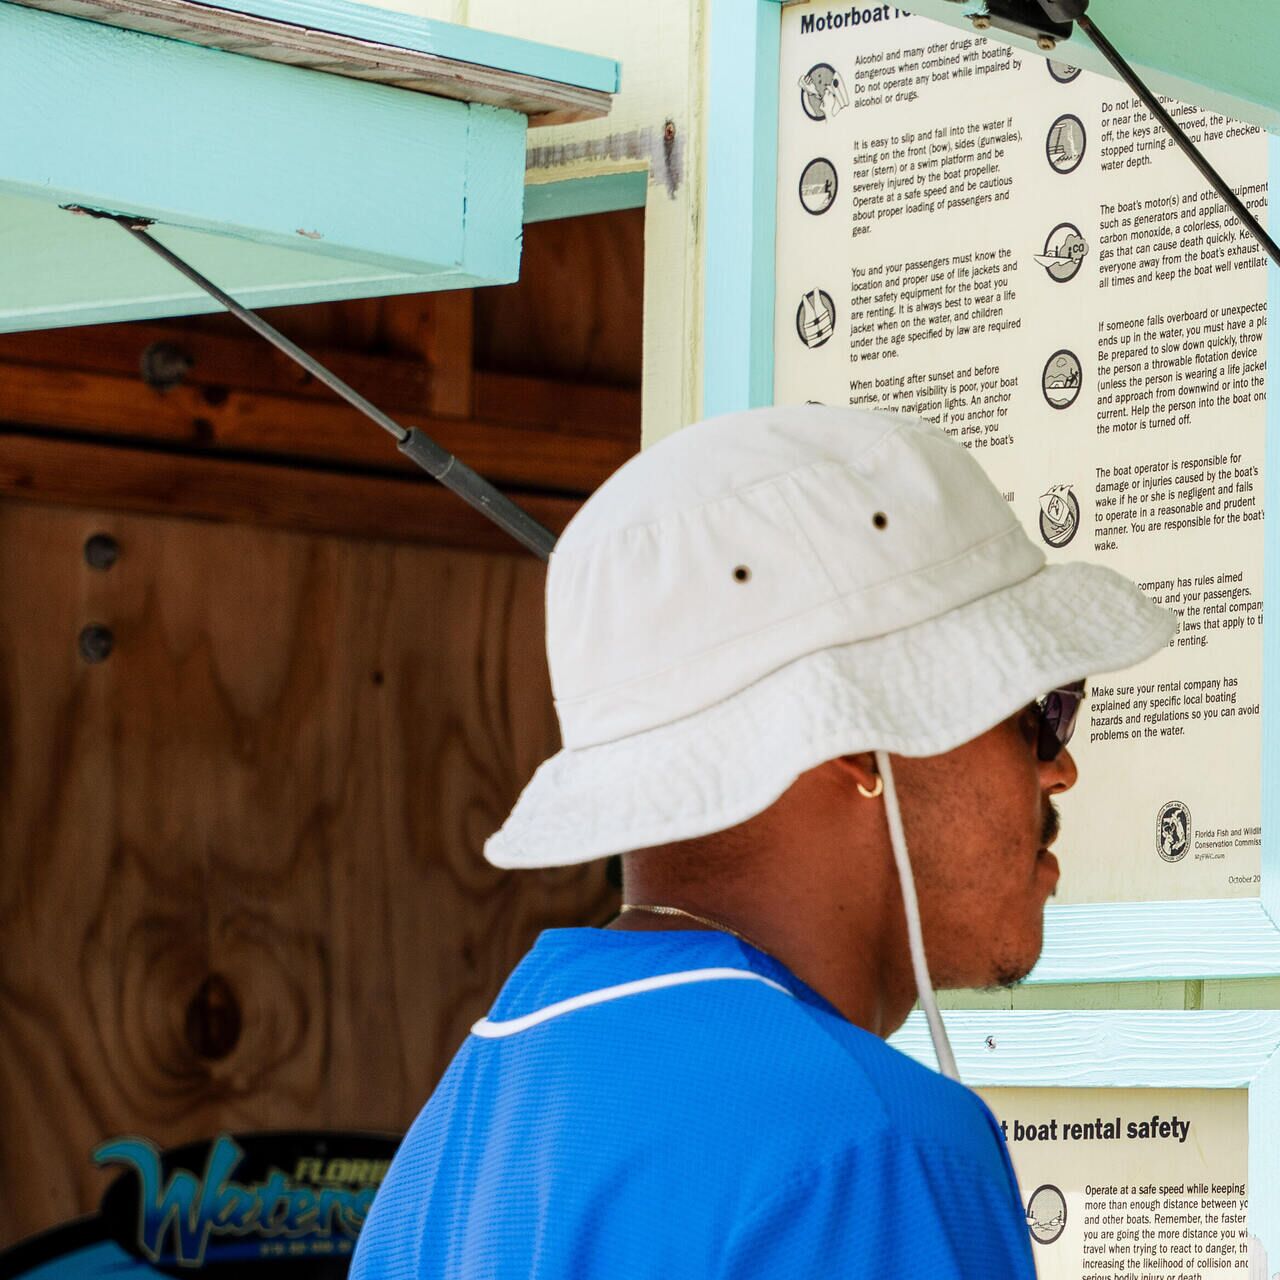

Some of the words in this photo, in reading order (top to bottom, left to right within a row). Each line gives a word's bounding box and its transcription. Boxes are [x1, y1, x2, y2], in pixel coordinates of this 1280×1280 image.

[801, 4, 889, 34] Motorboat
[853, 52, 884, 66] Alcohol
[885, 49, 901, 61] and
[902, 47, 925, 61] many
[926, 42, 948, 55] other
[949, 38, 973, 54] drugs
[974, 38, 988, 47] are
[854, 64, 896, 82] dangerous
[897, 60, 919, 73] when
[921, 54, 960, 70] combined
[962, 51, 979, 63] with
[981, 45, 1014, 62] boating.
[854, 83, 865, 94] Do
[867, 81, 880, 92] not
[882, 76, 913, 92] operate
[915, 76, 929, 87] any
[931, 70, 949, 83] boat
[951, 67, 972, 79] while
[974, 61, 1010, 78] impaired
[1012, 59, 1021, 73] by
[853, 94, 883, 108] alcohol
[884, 95, 893, 104] or
[894, 89, 921, 105] drugs.
[1091, 685, 1114, 697] Make
[1116, 686, 1134, 695] sure
[1136, 685, 1154, 696] your
[1156, 680, 1181, 692] rental
[1183, 680, 1221, 693] company
[1222, 676, 1238, 687] has
[1090, 698, 1130, 714] explained
[1132, 700, 1147, 711] any
[1149, 695, 1181, 710] specific
[1183, 693, 1203, 705] local
[1205, 691, 1236, 706] boating
[1090, 713, 1123, 726] hazards
[1125, 712, 1141, 724] and
[1143, 709, 1189, 725] regulations
[1191, 710, 1201, 719] so
[1203, 709, 1218, 721] you
[1220, 708, 1236, 717] can
[1237, 703, 1260, 715] avoid
[1090, 728, 1130, 743] problems
[1131, 729, 1142, 738] on
[1144, 726, 1158, 737] the
[1159, 724, 1185, 736] water.
[1234, 837, 1261, 847] Commiss
[1243, 827, 1261, 836] Wildli
[1013, 1119, 1058, 1142] boat
[1063, 1117, 1121, 1140] rental
[1126, 1116, 1190, 1143] safety
[294, 1158, 389, 1184] FLORI
[94, 1135, 377, 1267] Waters
[1084, 1184, 1118, 1198] Operate
[1119, 1184, 1128, 1194] at
[1130, 1186, 1136, 1194] a
[1138, 1183, 1156, 1194] safe
[1158, 1183, 1184, 1197] speed
[1186, 1183, 1209, 1194] while
[1210, 1183, 1245, 1196] keeping
[1084, 1201, 1106, 1209] more
[1108, 1198, 1127, 1209] than
[1129, 1198, 1161, 1212] enough
[1162, 1198, 1198, 1209] distance
[1200, 1197, 1237, 1208] between
[1239, 1200, 1248, 1211] yo
[1083, 1213, 1100, 1224] and
[1101, 1213, 1124, 1224] other
[1126, 1213, 1151, 1224] boats.
[1153, 1213, 1202, 1226] Remember,
[1204, 1213, 1219, 1223] the
[1220, 1212, 1247, 1223] faster
